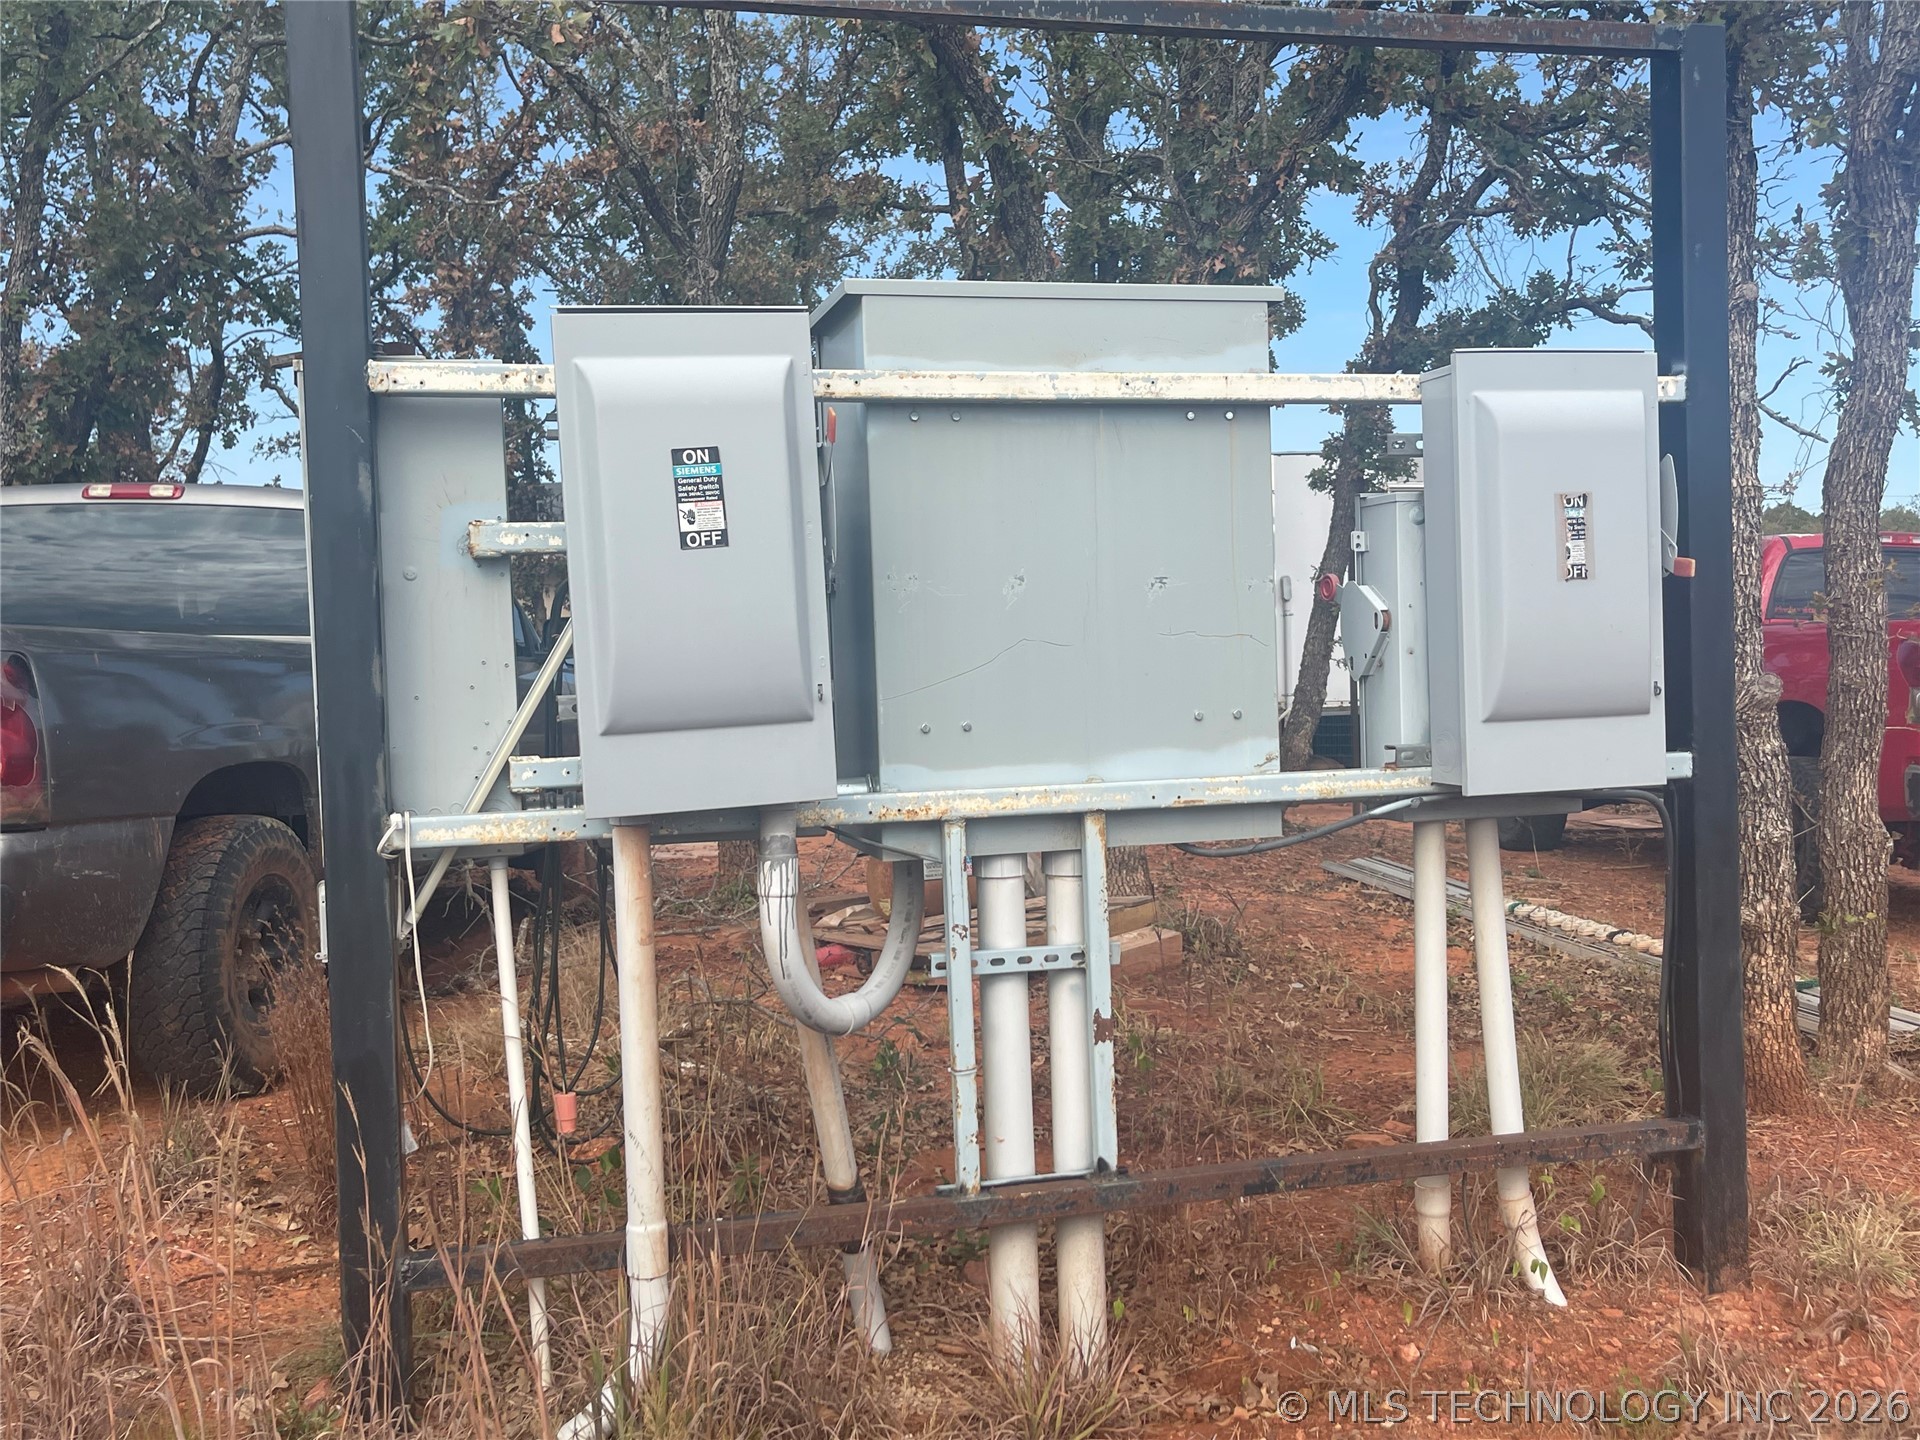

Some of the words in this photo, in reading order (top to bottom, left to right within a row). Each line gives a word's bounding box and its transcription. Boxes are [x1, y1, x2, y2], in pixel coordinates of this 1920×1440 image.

[682, 448, 710, 464] ON
[676, 465, 717, 476] SIEMENS
[686, 530, 722, 548] OFF
